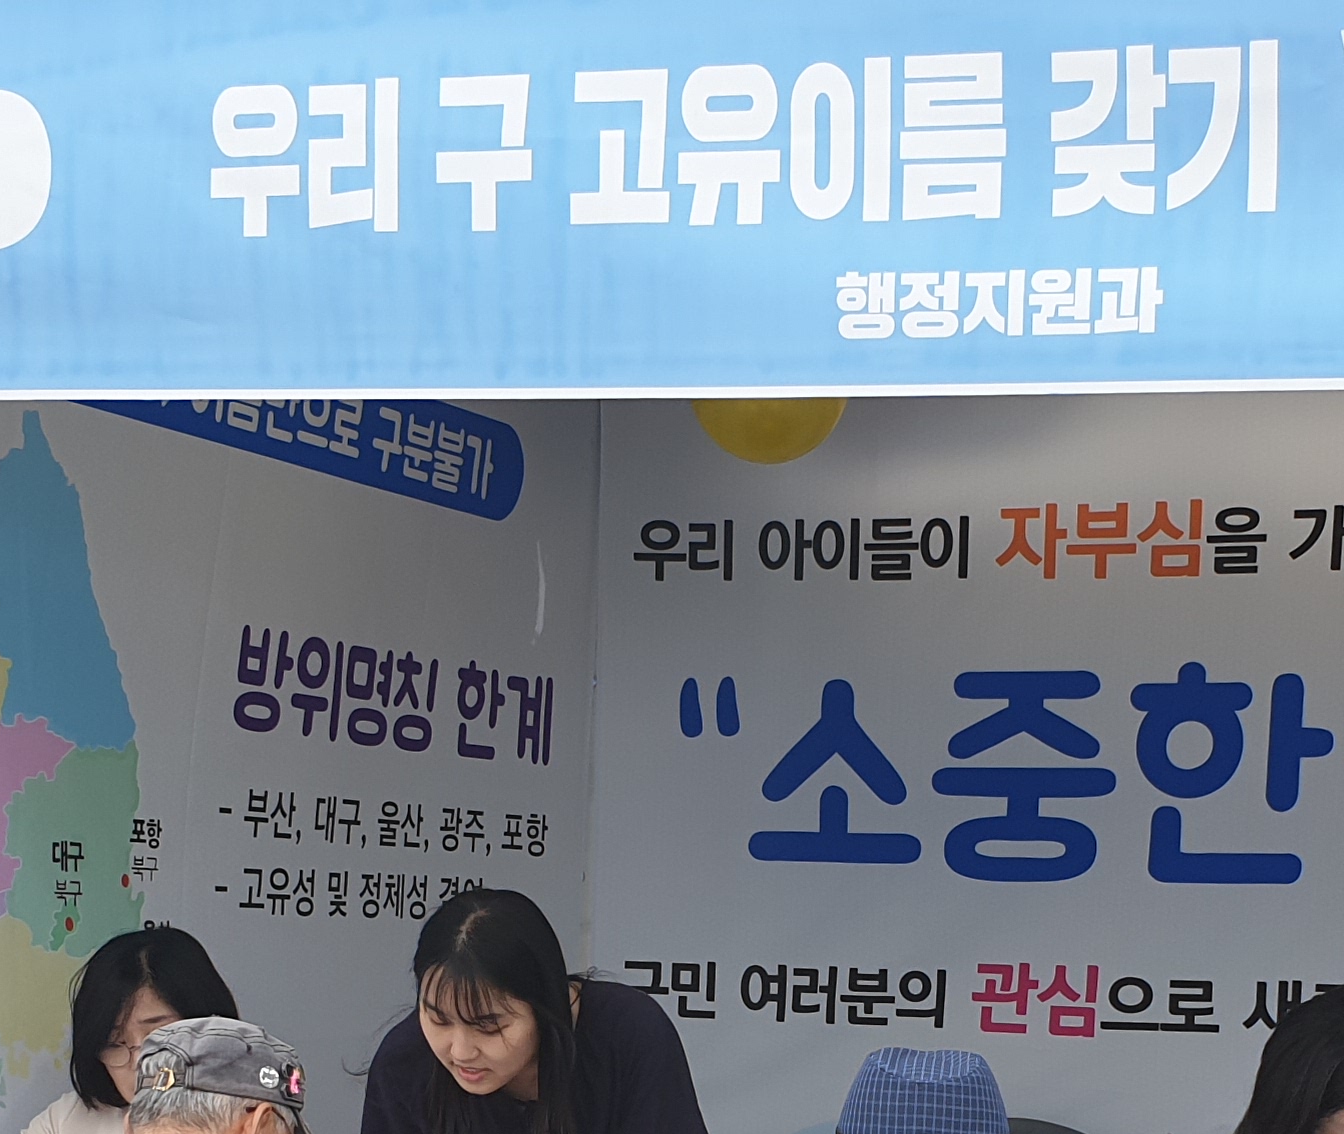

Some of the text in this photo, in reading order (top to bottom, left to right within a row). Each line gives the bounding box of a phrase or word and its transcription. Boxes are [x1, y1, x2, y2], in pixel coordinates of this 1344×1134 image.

[211, 77, 398, 237] 우리
[436, 74, 532, 233] 구
[570, 52, 1006, 225] 고유이름
[1051, 40, 1278, 217] 갖기
[835, 267, 1163, 340] 행정지원과
[372, 406, 494, 499] 구분불가
[633, 519, 734, 581] 우리
[759, 516, 970, 581] 아이들이
[995, 499, 1267, 580] 자부심을
[233, 624, 554, 766] 방위명칭 한계
[52, 840, 84, 873] 대구
[130, 819, 163, 849] 포항
[243, 789, 301, 844] 부산,
[314, 796, 367, 849] 대구,
[377, 801, 429, 853] 울산,
[440, 807, 492, 857] 광주,
[502, 813, 548, 857] 포항
[54, 880, 83, 906] 북구
[131, 856, 159, 882] 북구
[239, 868, 316, 917] 고유성
[328, 871, 349, 918] 및
[359, 872, 428, 919] 정체성
[740, 961, 947, 1028] 여러분의
[972, 962, 1220, 1038] 관심으로
